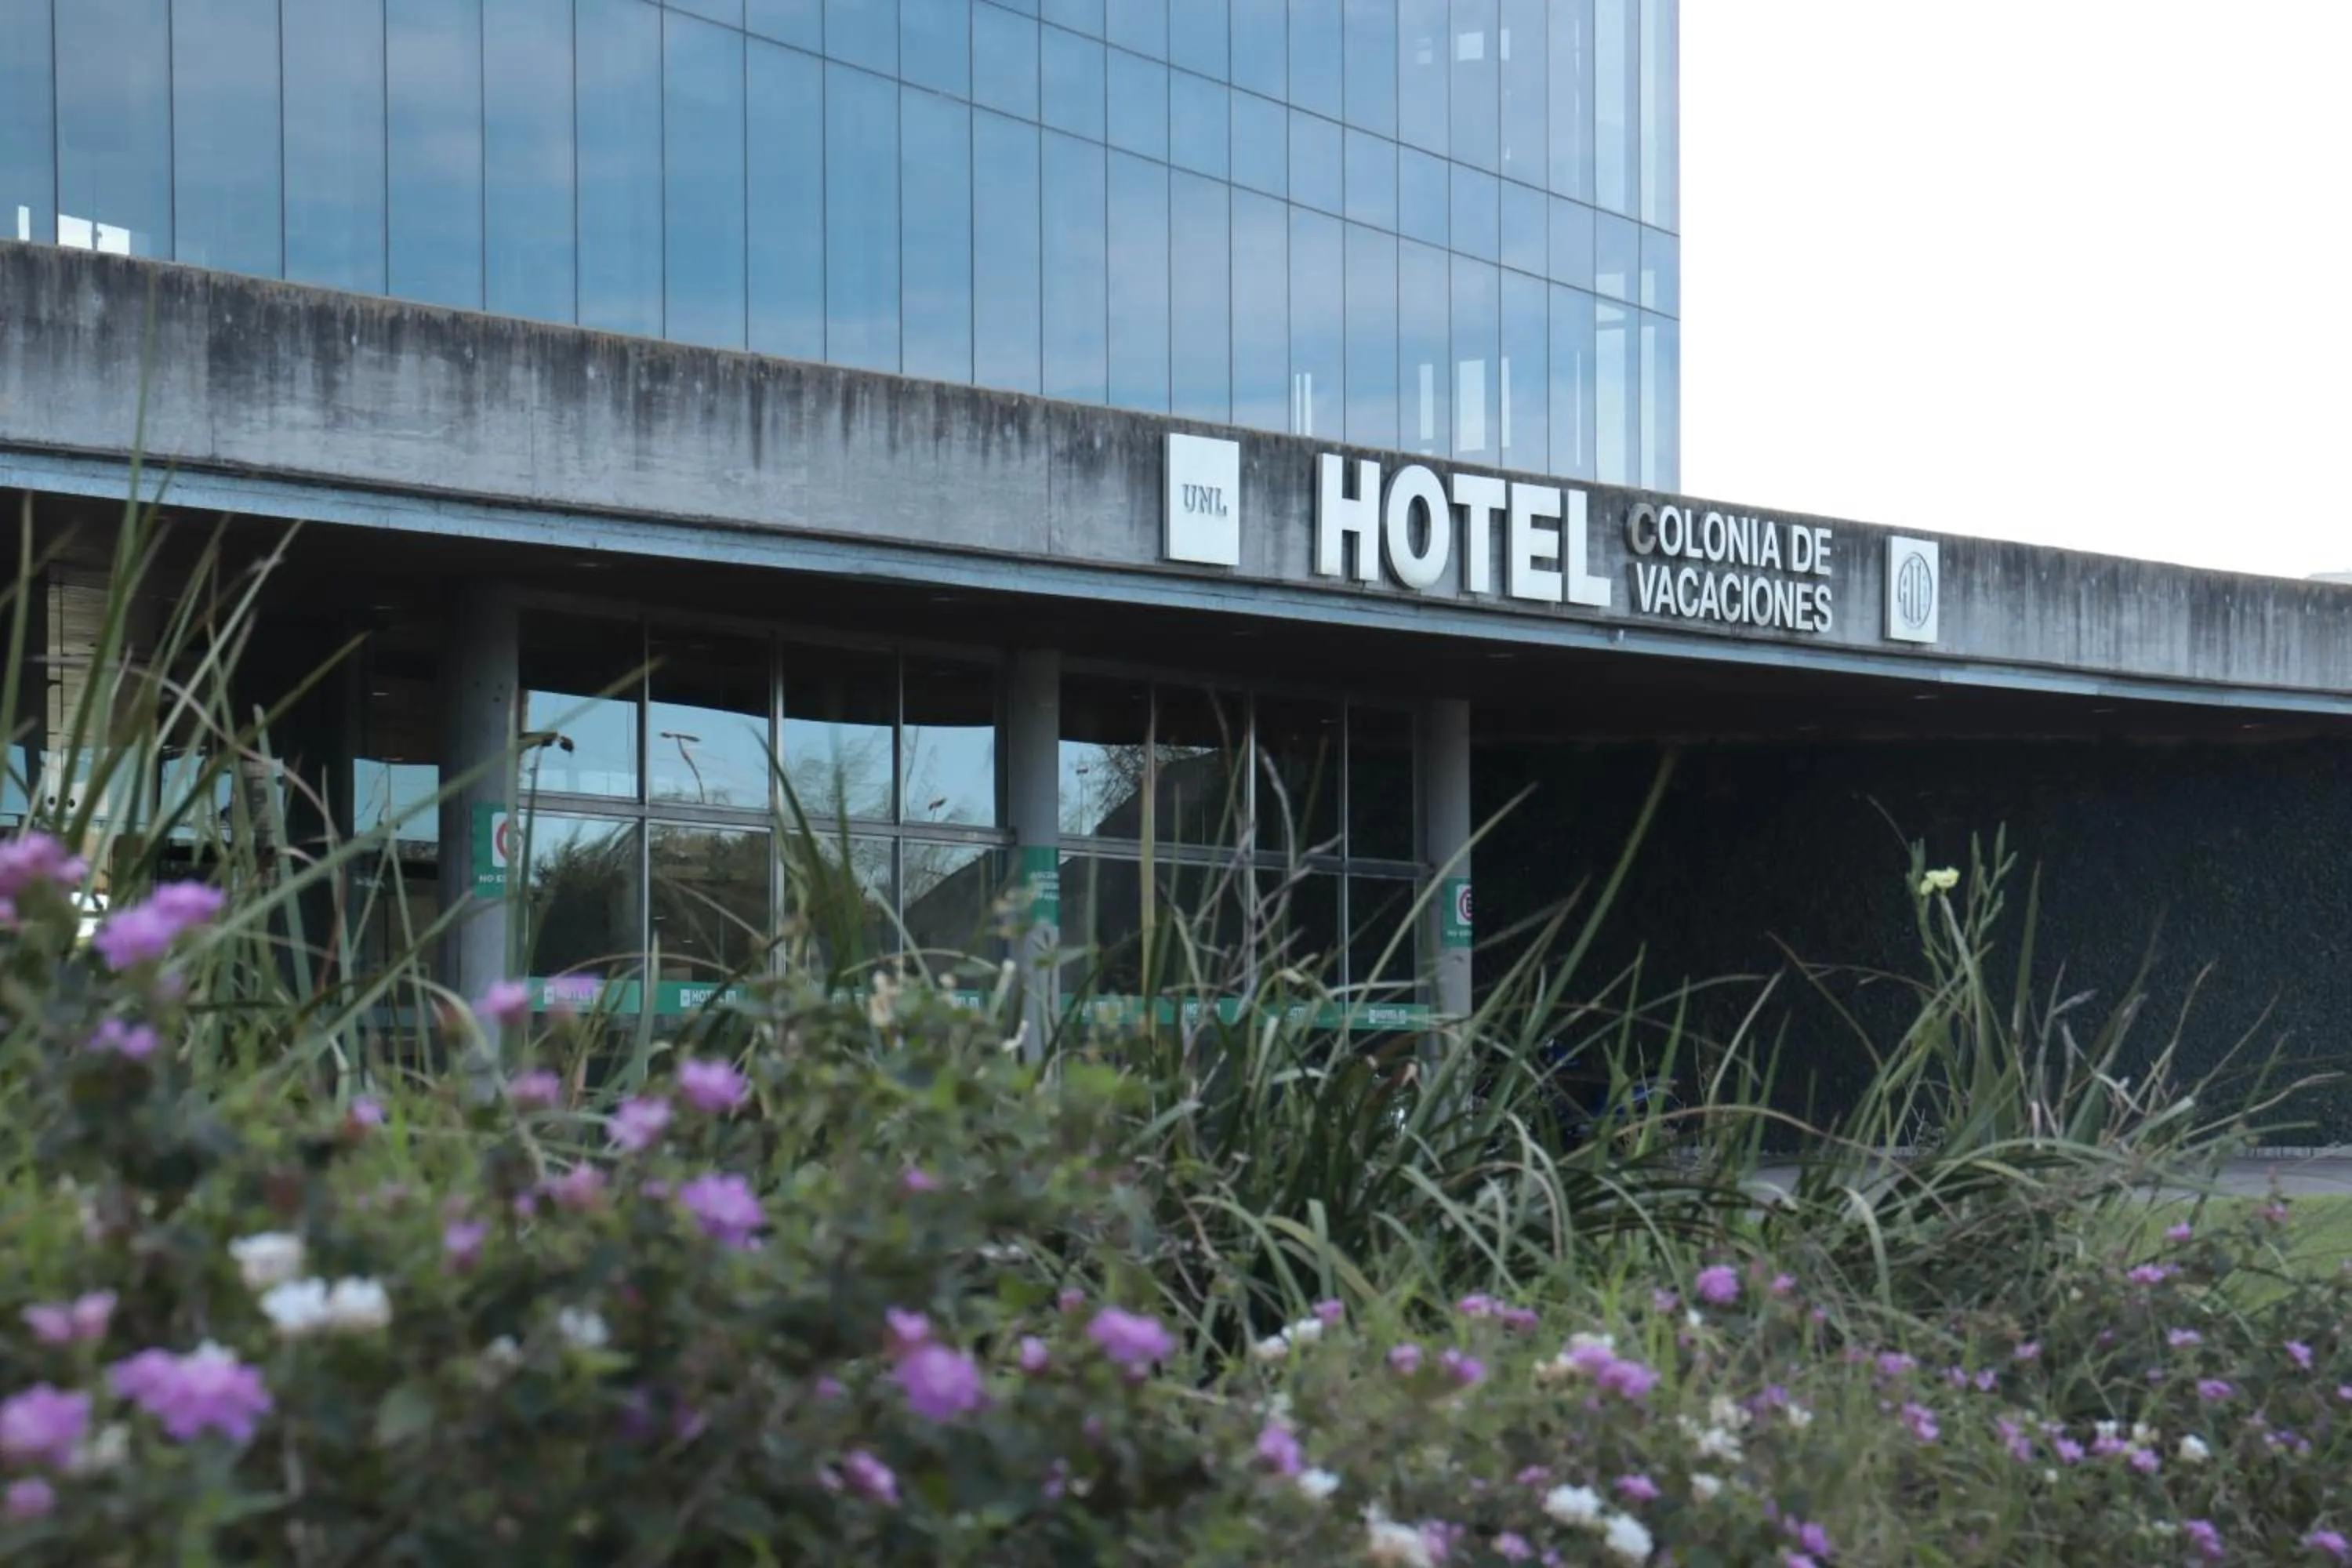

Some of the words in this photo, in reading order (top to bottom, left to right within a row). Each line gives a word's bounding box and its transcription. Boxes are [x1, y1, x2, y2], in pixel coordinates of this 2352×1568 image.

[1181, 483, 1228, 517] UNL
[1317, 452, 1611, 607] HOTEL
[1628, 502, 1782, 570] COLONIA
[1789, 524, 1833, 576] DE
[1635, 561, 1834, 633] VACACIONES
